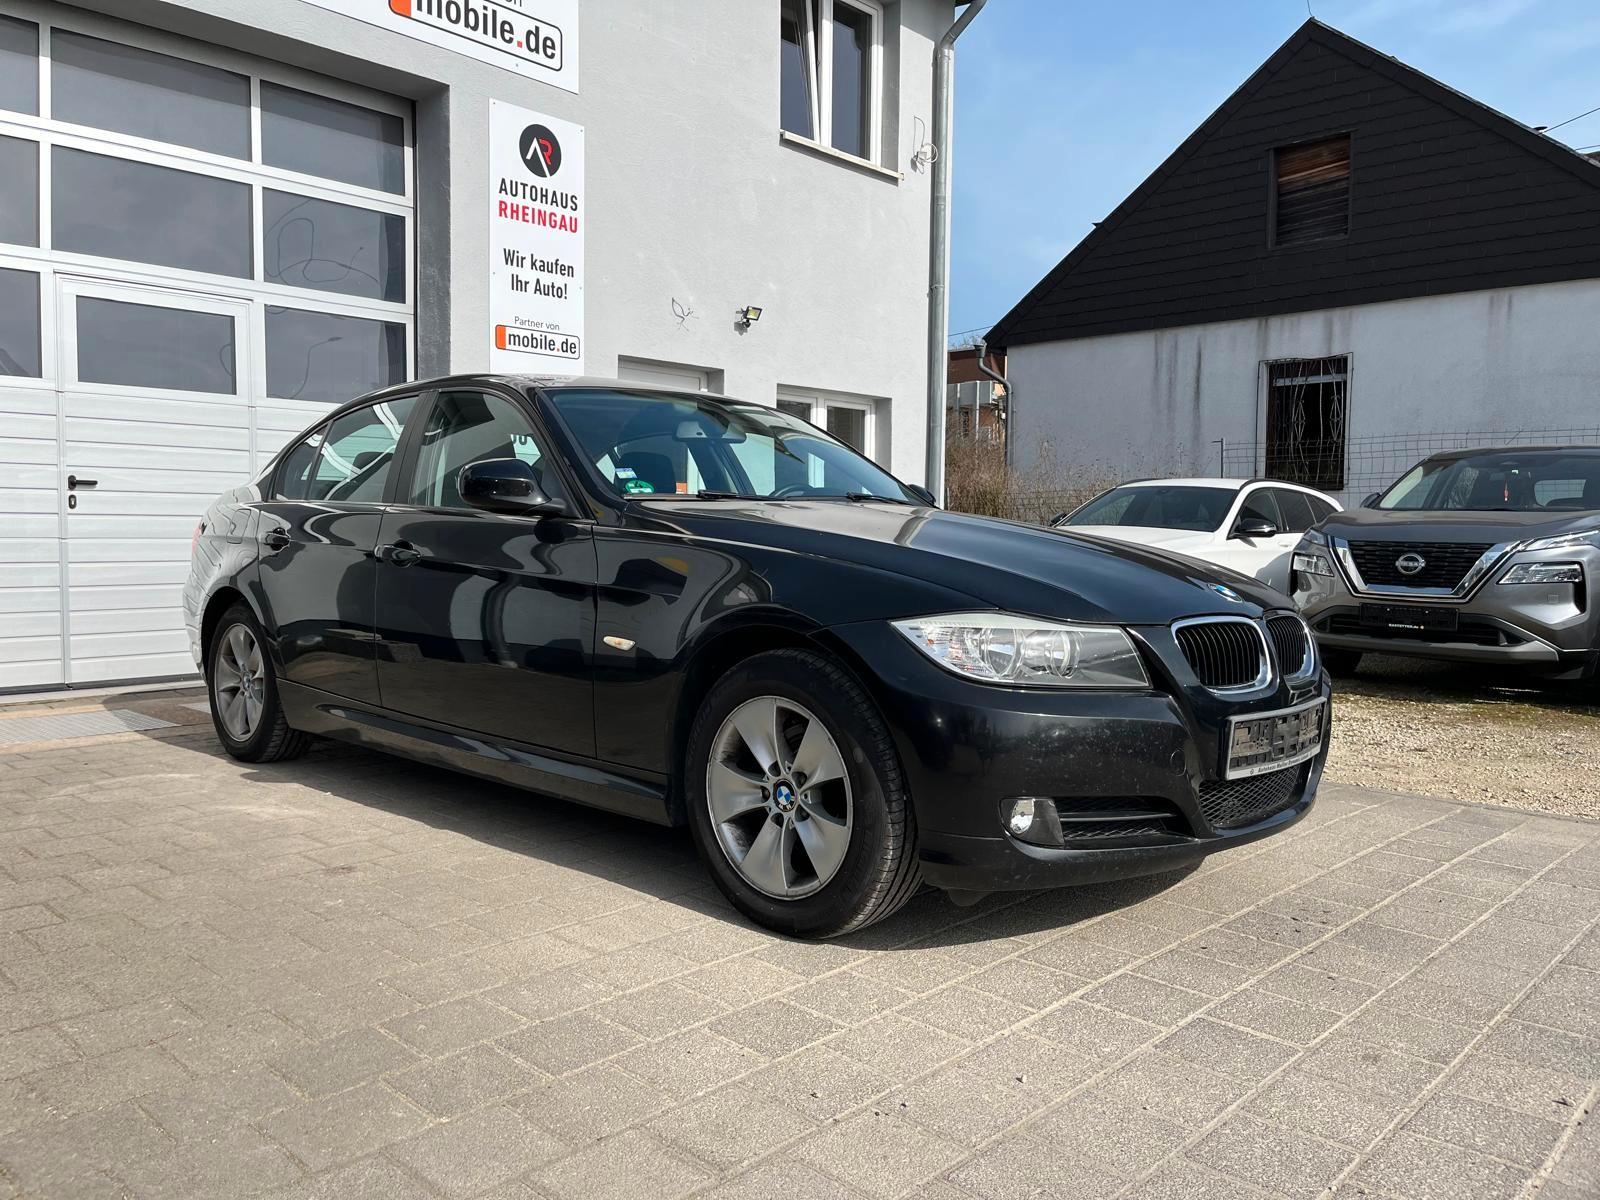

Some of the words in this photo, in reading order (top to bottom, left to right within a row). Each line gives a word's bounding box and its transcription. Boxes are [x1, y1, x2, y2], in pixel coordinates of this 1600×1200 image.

[499, 178, 578, 211] AUTOHAUS
[499, 200, 578, 233] RHEINGAU
[503, 248, 526, 269] Wir
[530, 253, 574, 278] kaufen
[511, 274, 529, 293] Ihr
[534, 278, 568, 300] Auto!
[514, 316, 544, 329] Partner
[545, 322, 560, 331] von
[508, 333, 577, 354] mobile.de
